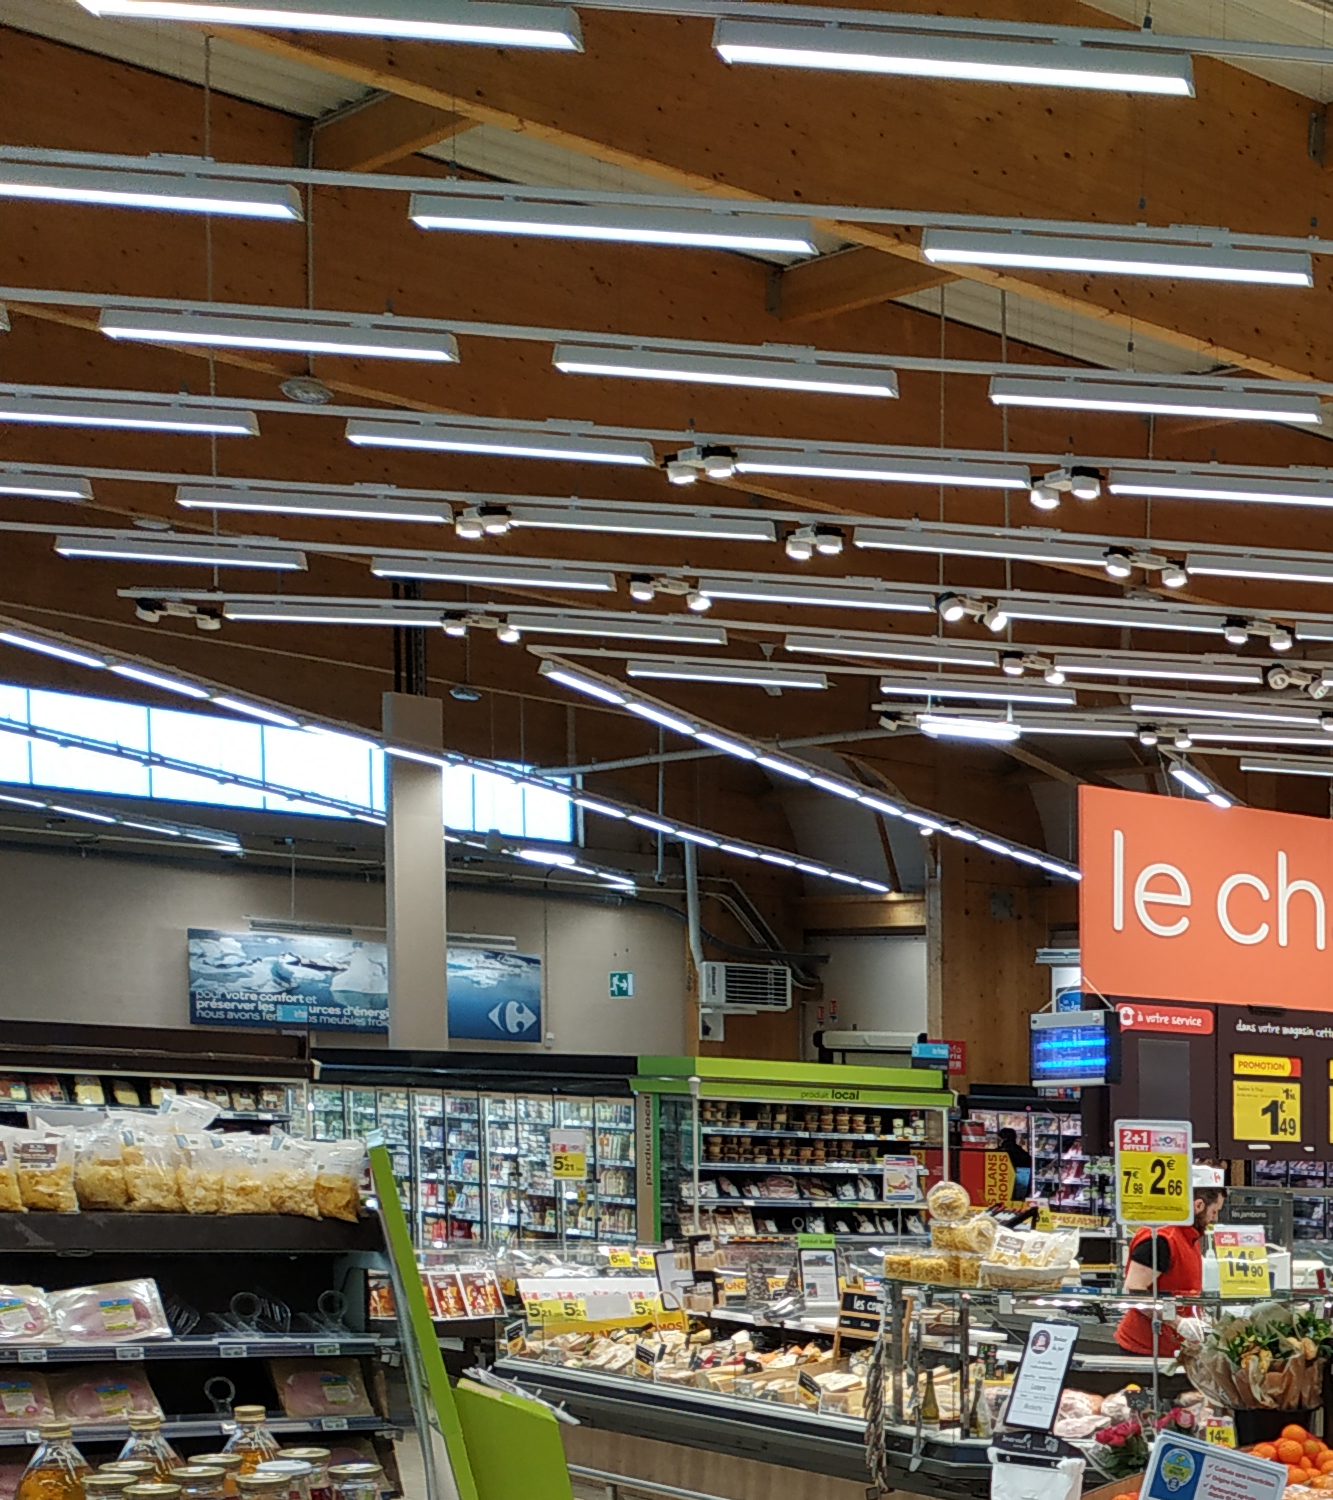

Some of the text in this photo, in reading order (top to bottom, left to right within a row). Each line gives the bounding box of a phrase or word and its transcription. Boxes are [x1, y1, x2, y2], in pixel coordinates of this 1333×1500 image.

[1113, 830, 1192, 936] le
[196, 990, 317, 1004] pour votre confort et
[196, 1001, 275, 1011] préserver les
[196, 1009, 366, 1025] nous avons meubles
[1137, 1011, 1202, 1026] à votre service
[1236, 1020, 1255, 1033] dans
[1258, 1023, 1280, 1035] votre
[1283, 1026, 1314, 1039] magasin
[1238, 1061, 1285, 1070] PROMOTION
[831, 1089, 859, 1100] local
[642, 1095, 653, 1186] produit local
[1124, 1132, 1147, 1143] 2+1
[988, 1155, 997, 1196] PLANS
